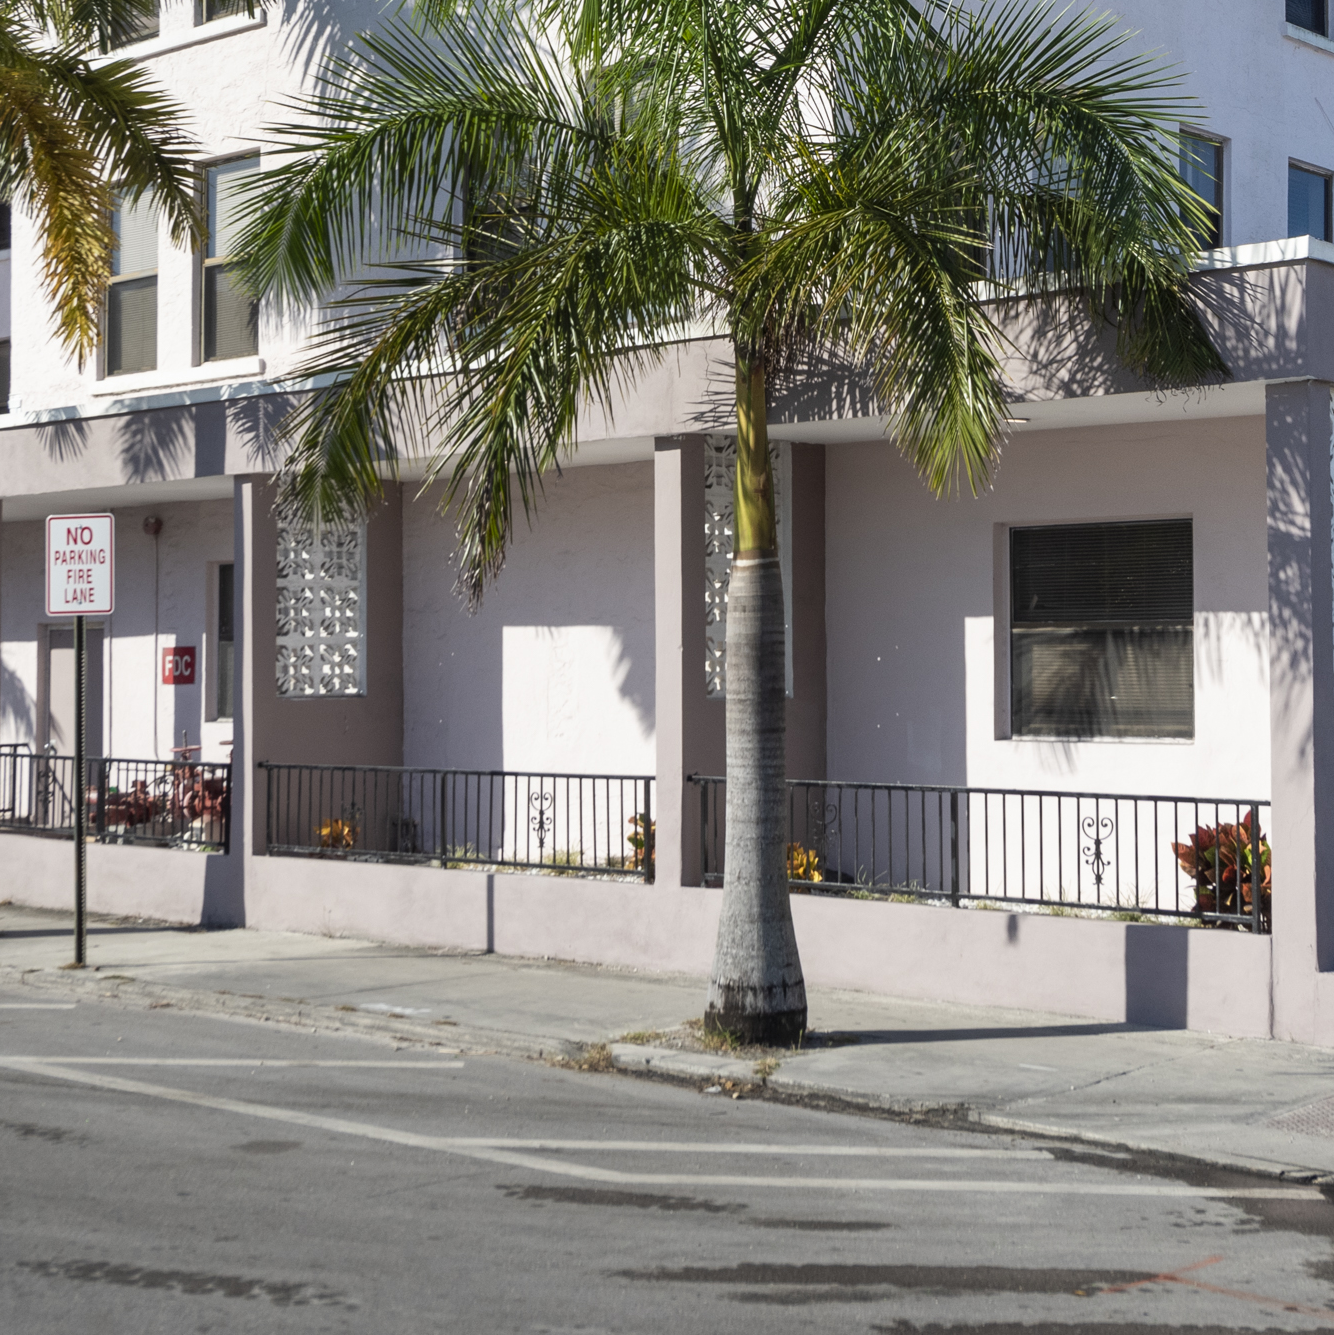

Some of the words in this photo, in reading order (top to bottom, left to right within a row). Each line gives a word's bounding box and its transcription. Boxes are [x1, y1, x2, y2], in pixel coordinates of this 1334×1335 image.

[66, 526, 93, 546] NO
[54, 548, 106, 566] PARKING
[66, 568, 93, 585] FIRE
[64, 587, 95, 604] LANE
[164, 655, 192, 677] FDC
